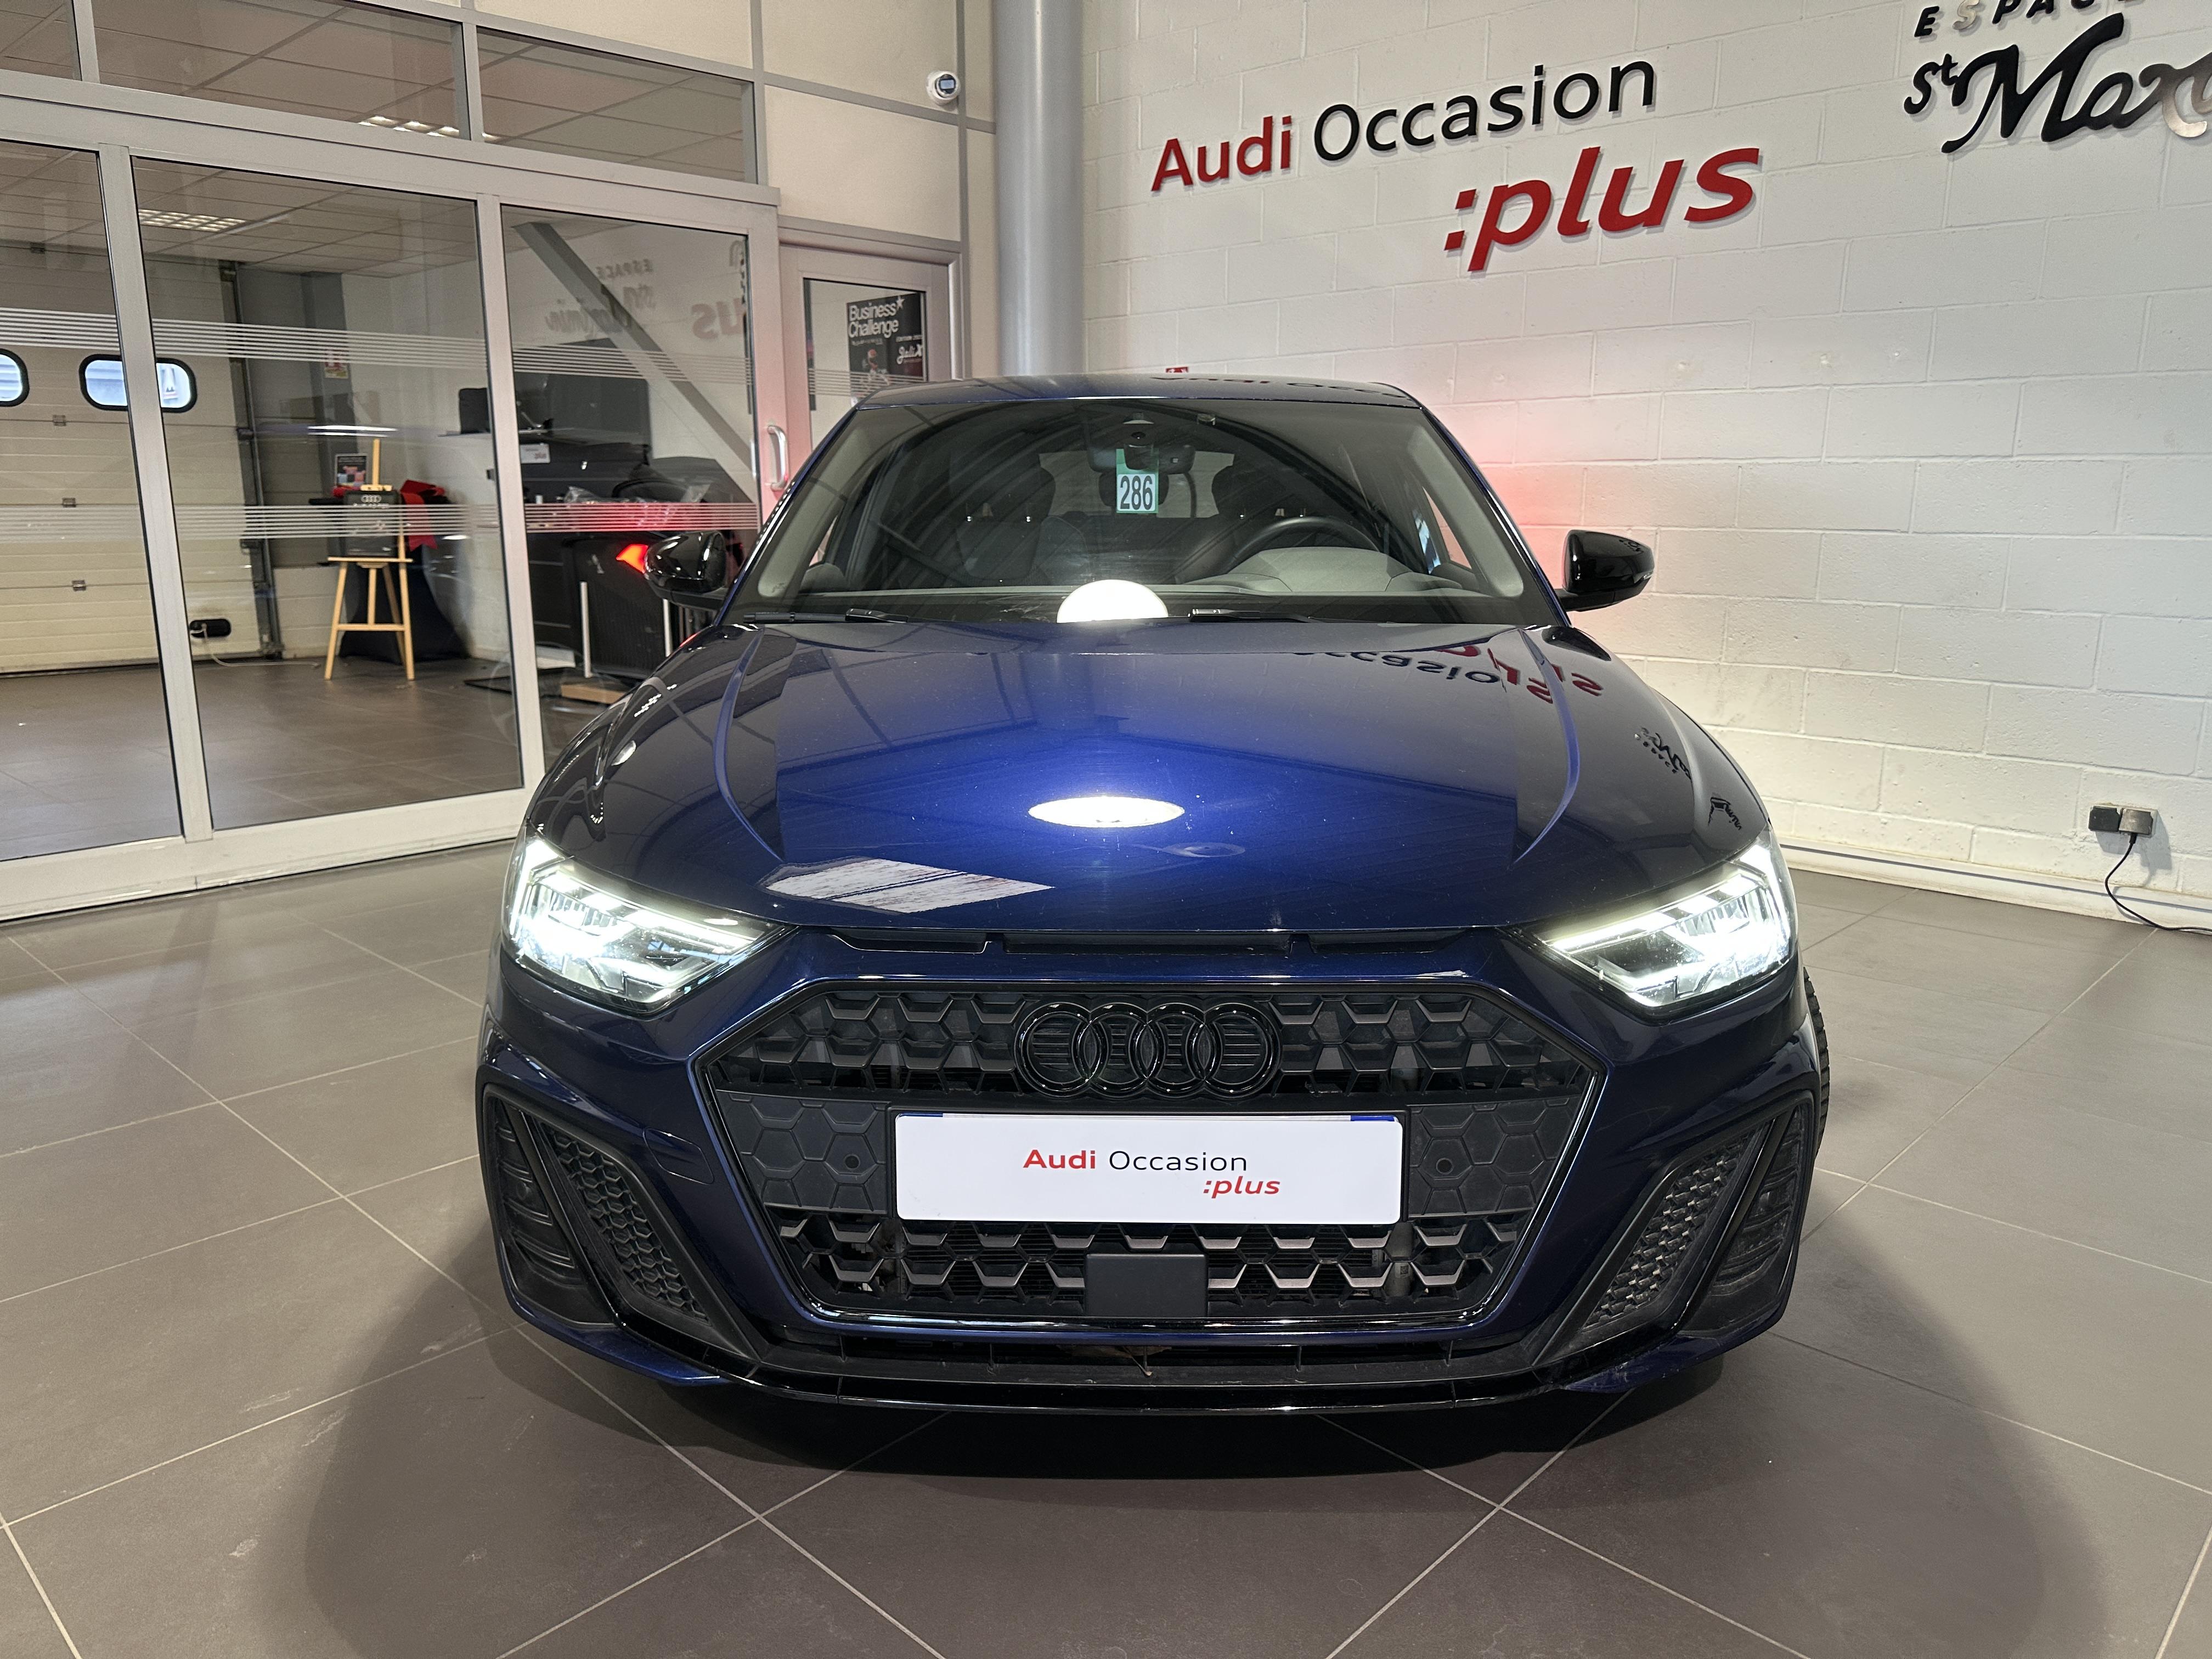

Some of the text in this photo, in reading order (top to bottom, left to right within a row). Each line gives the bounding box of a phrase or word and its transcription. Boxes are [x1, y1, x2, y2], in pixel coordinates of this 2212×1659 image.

[1152, 60, 1655, 191] Audi Occasion
[1444, 146, 1759, 272] :plus
[850, 302, 897, 321] Business
[849, 319, 899, 338] Challenge
[1120, 475, 1153, 511] 286
[1024, 1149, 1247, 1172] Audi Occasion
[1203, 1175, 1280, 1199] :plus
